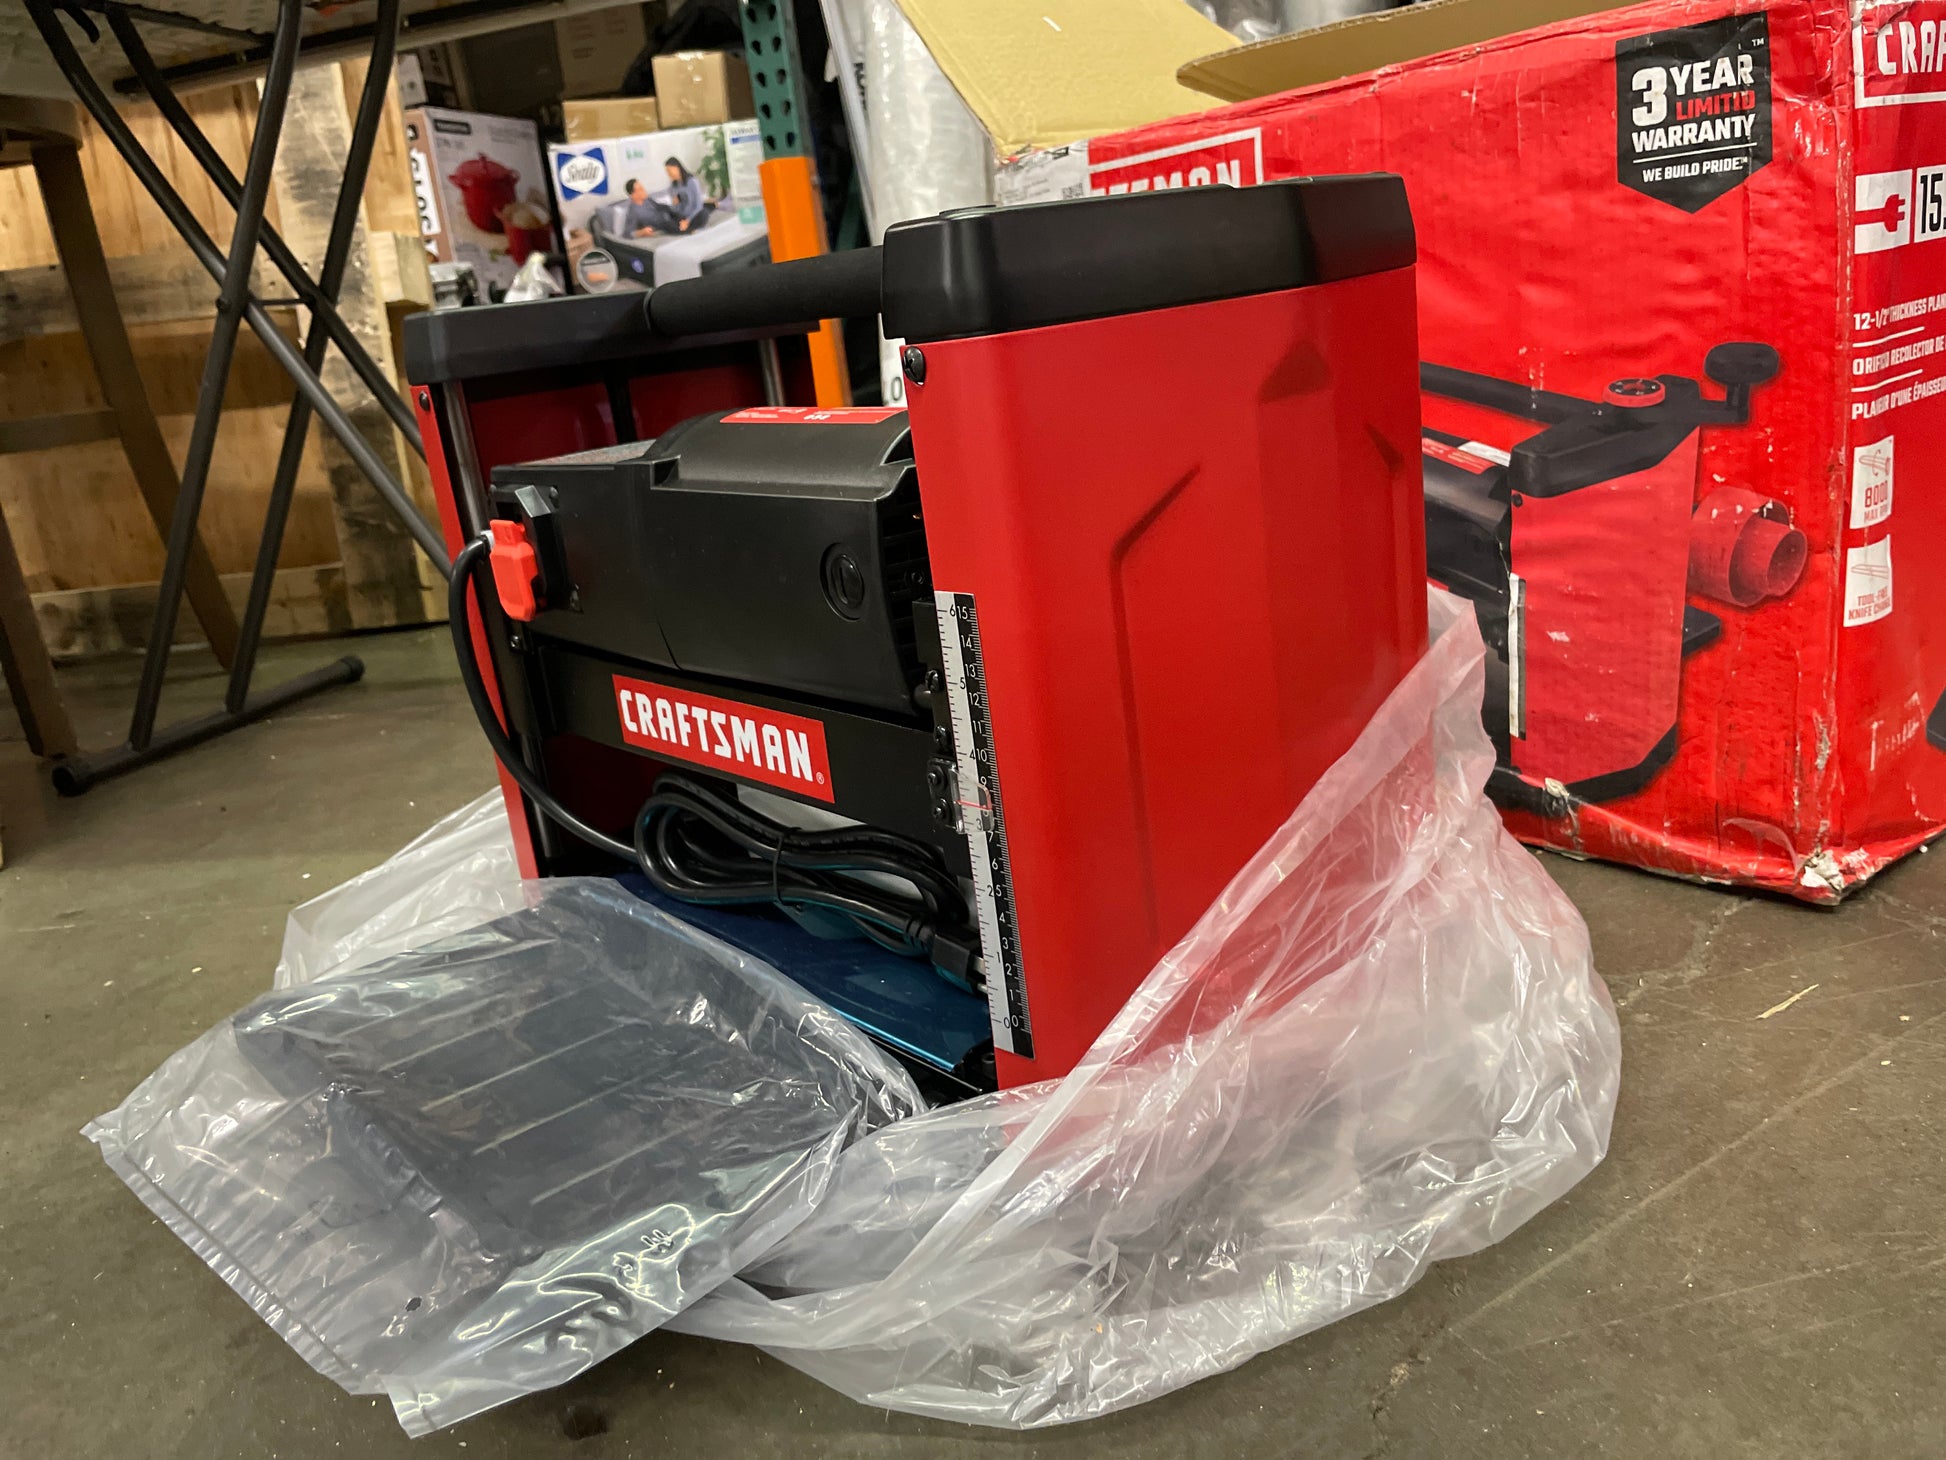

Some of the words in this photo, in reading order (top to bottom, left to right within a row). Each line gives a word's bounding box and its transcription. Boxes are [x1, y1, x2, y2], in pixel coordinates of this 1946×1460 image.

[1632, 66, 1668, 127] 3
[1669, 53, 1755, 96] YEAR
[1631, 113, 1756, 153] WARRANTY
[1641, 168, 1662, 183] WE
[1664, 162, 1700, 180] BUILD
[949, 604, 956, 617] 6
[957, 605, 968, 619] 15
[961, 635, 972, 649] 14
[965, 664, 976, 678] 13
[959, 677, 966, 690] 5
[968, 692, 980, 706] 12
[972, 720, 982, 734] 11
[969, 749, 976, 760] 4
[976, 748, 988, 762] 10
[976, 818, 982, 830] 3
[987, 830, 994, 843] 7
[991, 857, 999, 870] 6
[987, 885, 994, 897] 2
[995, 885, 1002, 897] 5
[999, 912, 1006, 924] 4
[1002, 937, 1009, 950] 3
[996, 951, 1001, 964] 1
[1005, 963, 1012, 976] 2
[1009, 989, 1014, 1001] 1
[1003, 1016, 1010, 1029] 0
[1011, 1014, 1019, 1027] 0
